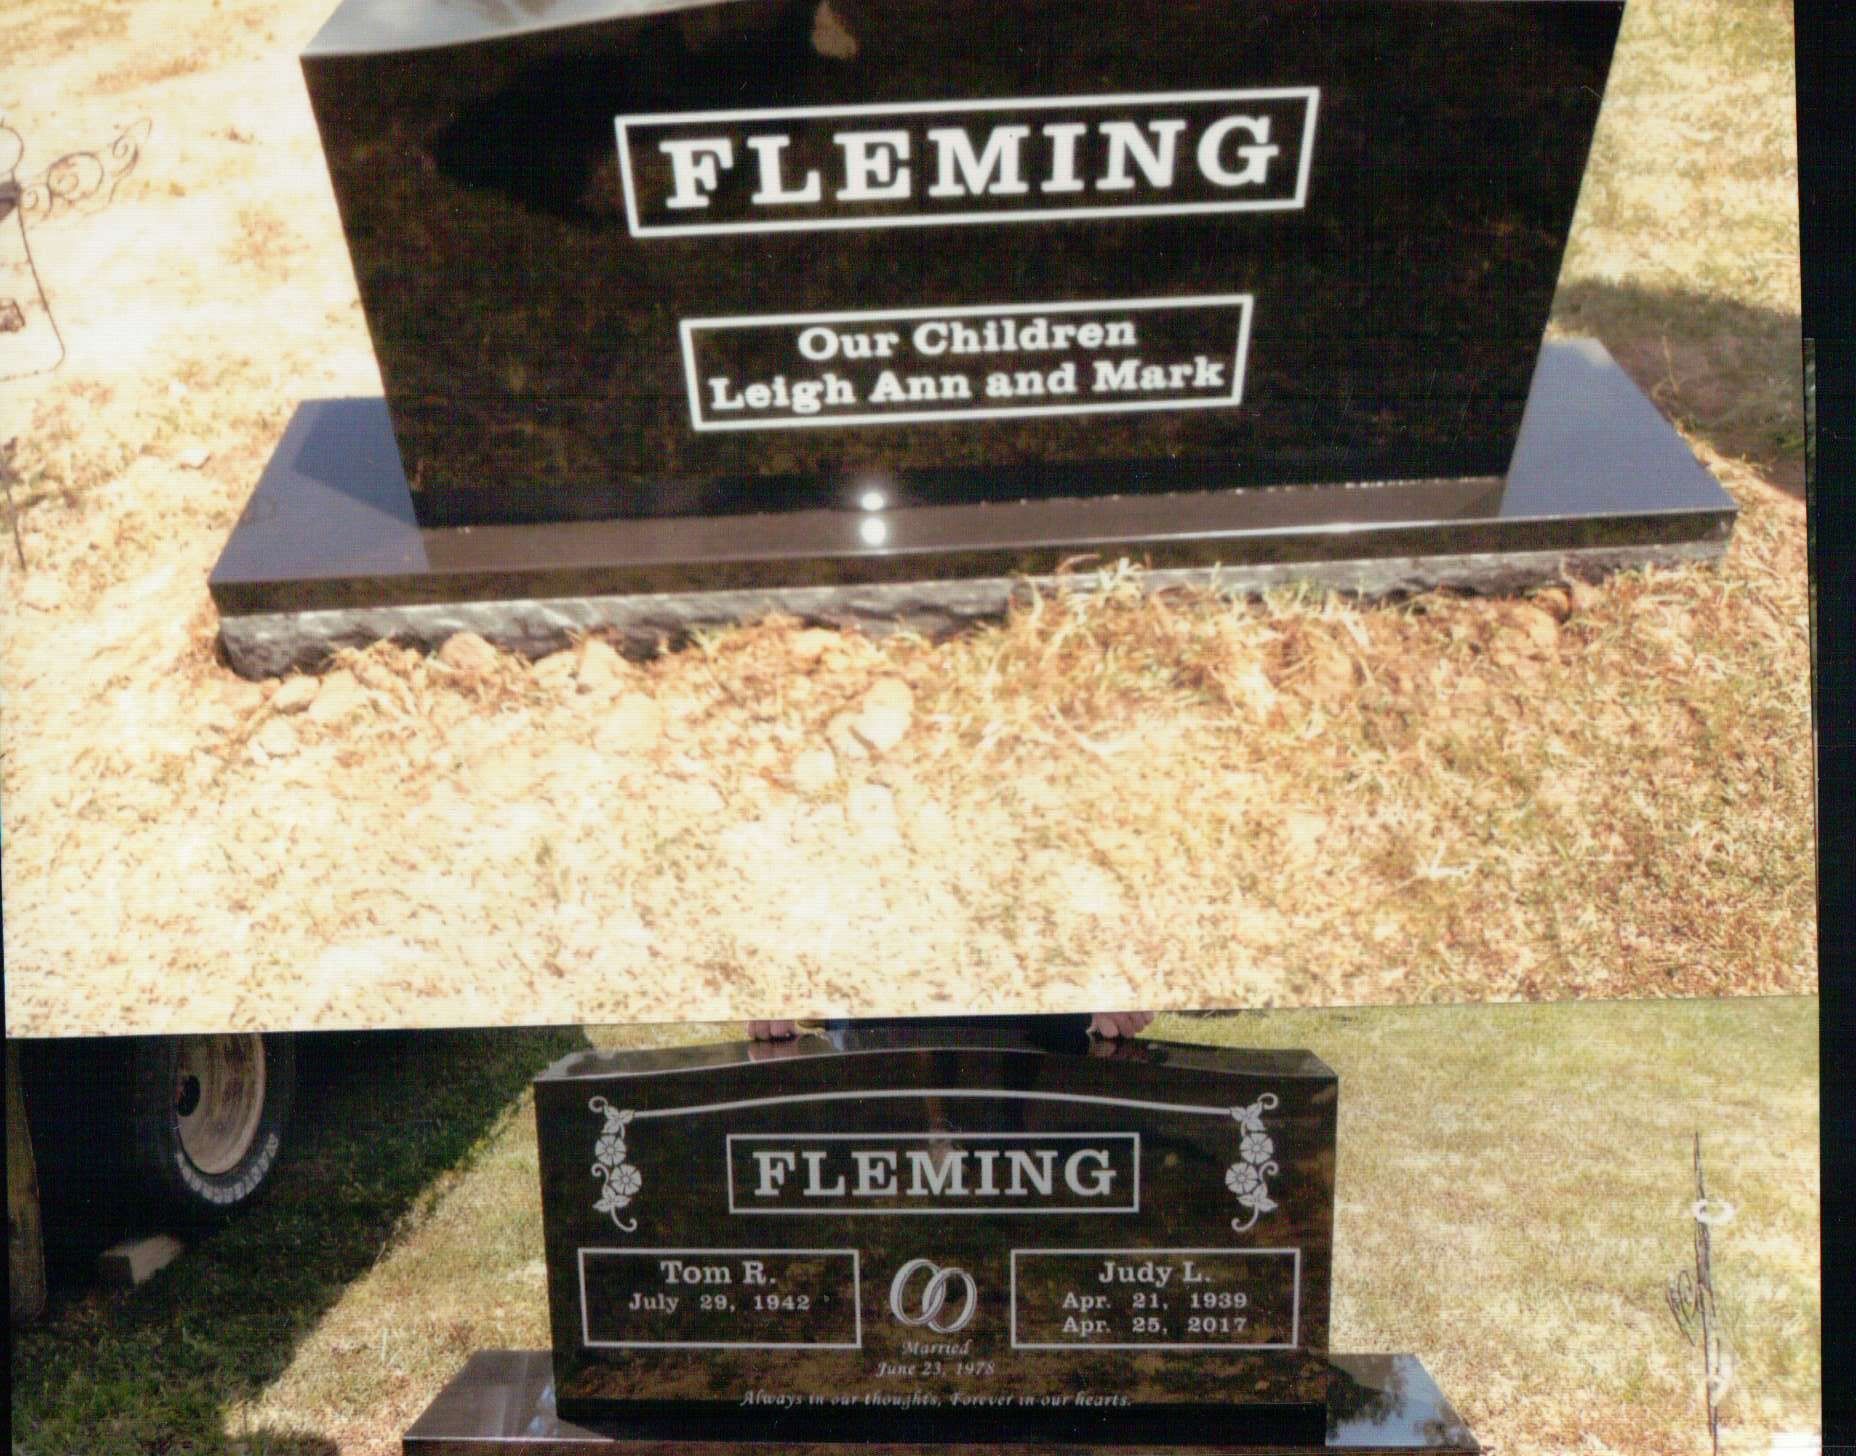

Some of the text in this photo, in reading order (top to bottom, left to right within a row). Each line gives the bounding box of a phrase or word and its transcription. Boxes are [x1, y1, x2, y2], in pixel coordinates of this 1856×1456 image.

[658, 115, 1280, 209] FLEMING
[797, 317, 1137, 360] Our Children
[708, 356, 1225, 413] Leigh Ann and Mark
[751, 1147, 1118, 1197] FLEMING
[660, 1260, 776, 1284] Tom R.
[1099, 1261, 1211, 1287] Judy L.
[629, 1292, 811, 1313] July 29, 1942
[1062, 1291, 1248, 1312] Apr. 21, 1939
[1062, 1316, 1247, 1337] Apr. 25, 2017
[901, 1339, 973, 1355] Married
[876, 1360, 996, 1377] June 23, 1978
[740, 1389, 801, 1409] Always
[808, 1391, 824, 1406] in
[830, 1394, 857, 1406] our
[951, 1392, 1013, 1407] Forever
[1019, 1392, 1036, 1406] in
[1041, 1395, 1067, 1407] our
[1072, 1390, 1132, 1407] hearts.
